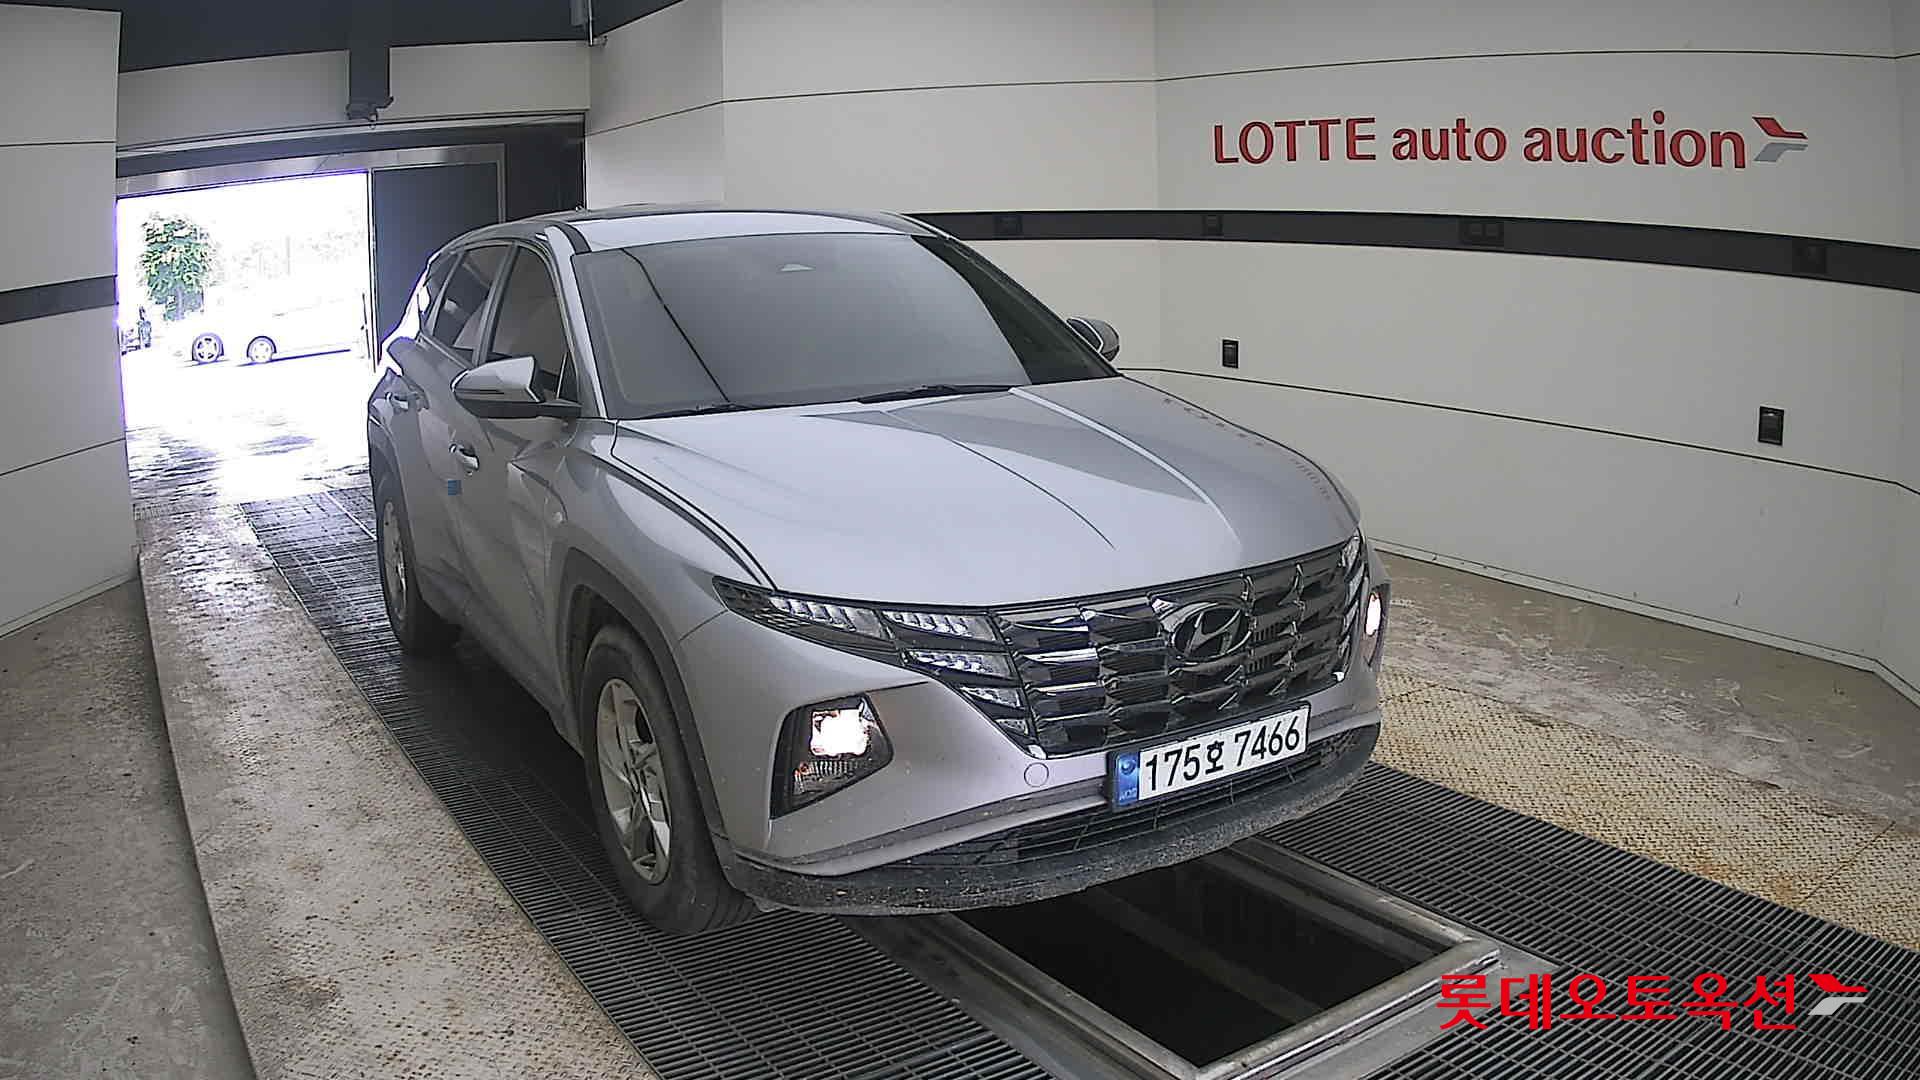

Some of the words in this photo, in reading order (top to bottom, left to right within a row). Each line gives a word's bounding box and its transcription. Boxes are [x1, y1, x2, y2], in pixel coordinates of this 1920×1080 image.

[1213, 116, 1377, 164] LOTTE
[1392, 117, 1508, 162] auto
[1523, 110, 1747, 169] auction
[1145, 740, 1225, 791] 175호
[1234, 716, 1301, 767] 7466
